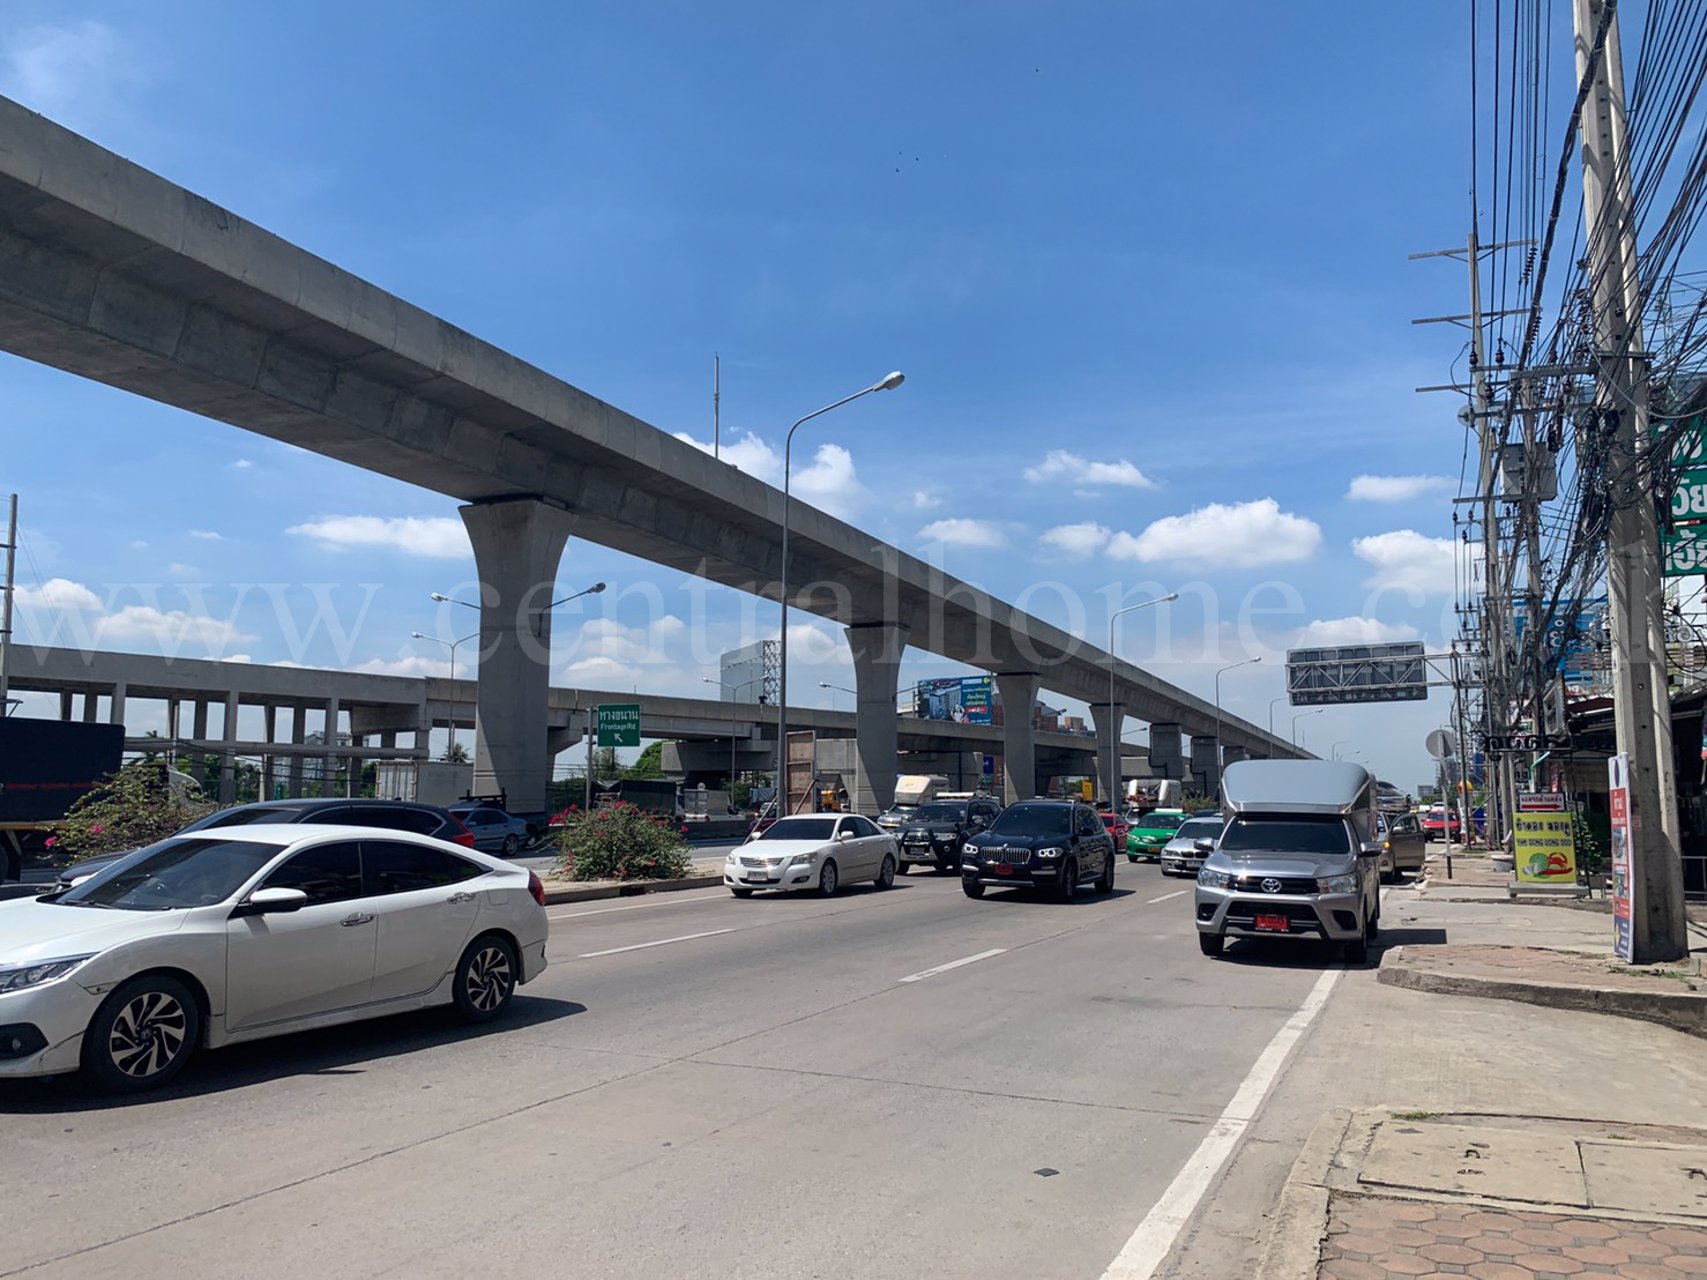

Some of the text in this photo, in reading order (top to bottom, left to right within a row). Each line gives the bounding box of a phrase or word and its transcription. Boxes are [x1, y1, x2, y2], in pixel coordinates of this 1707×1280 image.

[599, 711, 639, 720] ทางขนาน
[600, 723, 626, 731] Frontage
